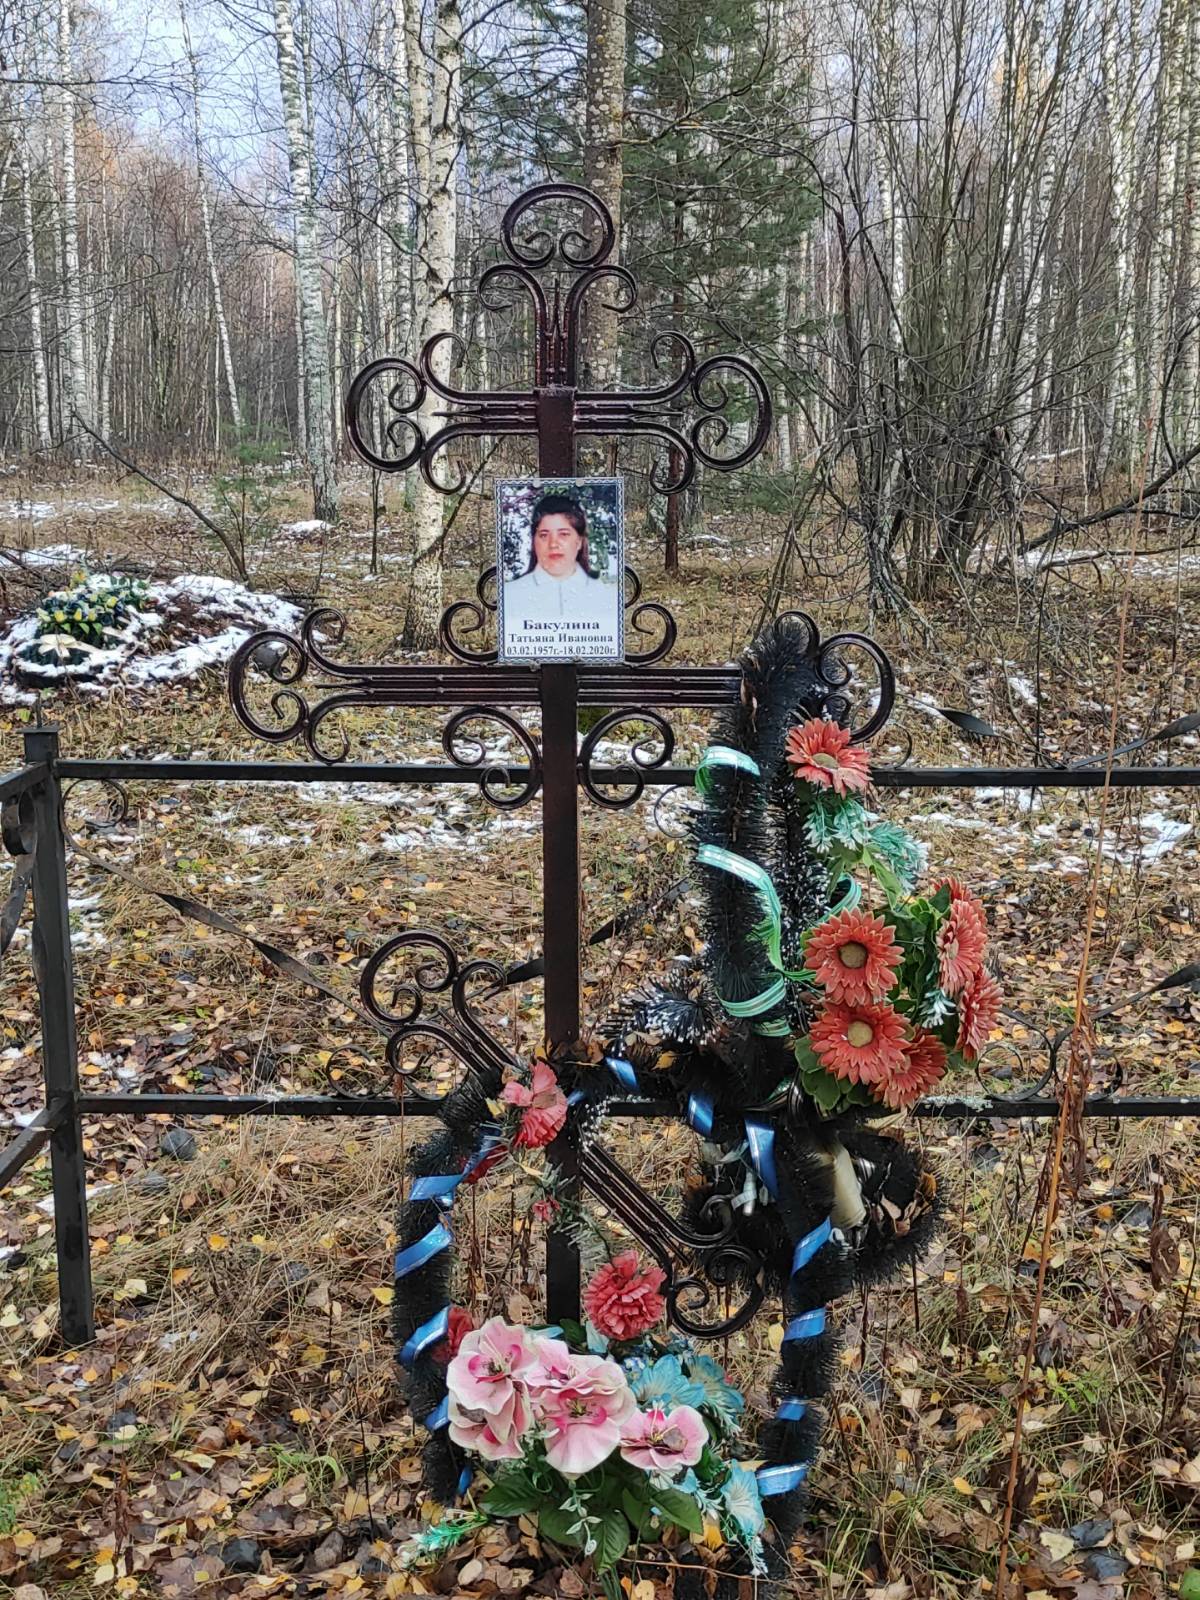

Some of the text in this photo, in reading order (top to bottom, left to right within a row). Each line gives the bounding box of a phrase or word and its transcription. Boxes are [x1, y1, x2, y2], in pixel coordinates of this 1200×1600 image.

[523, 619, 600, 632] Бакулина
[509, 633, 613, 643] Татьяна Ивановна
[506, 645, 616, 656] 03.02.1957г.-18.02.2020г.
